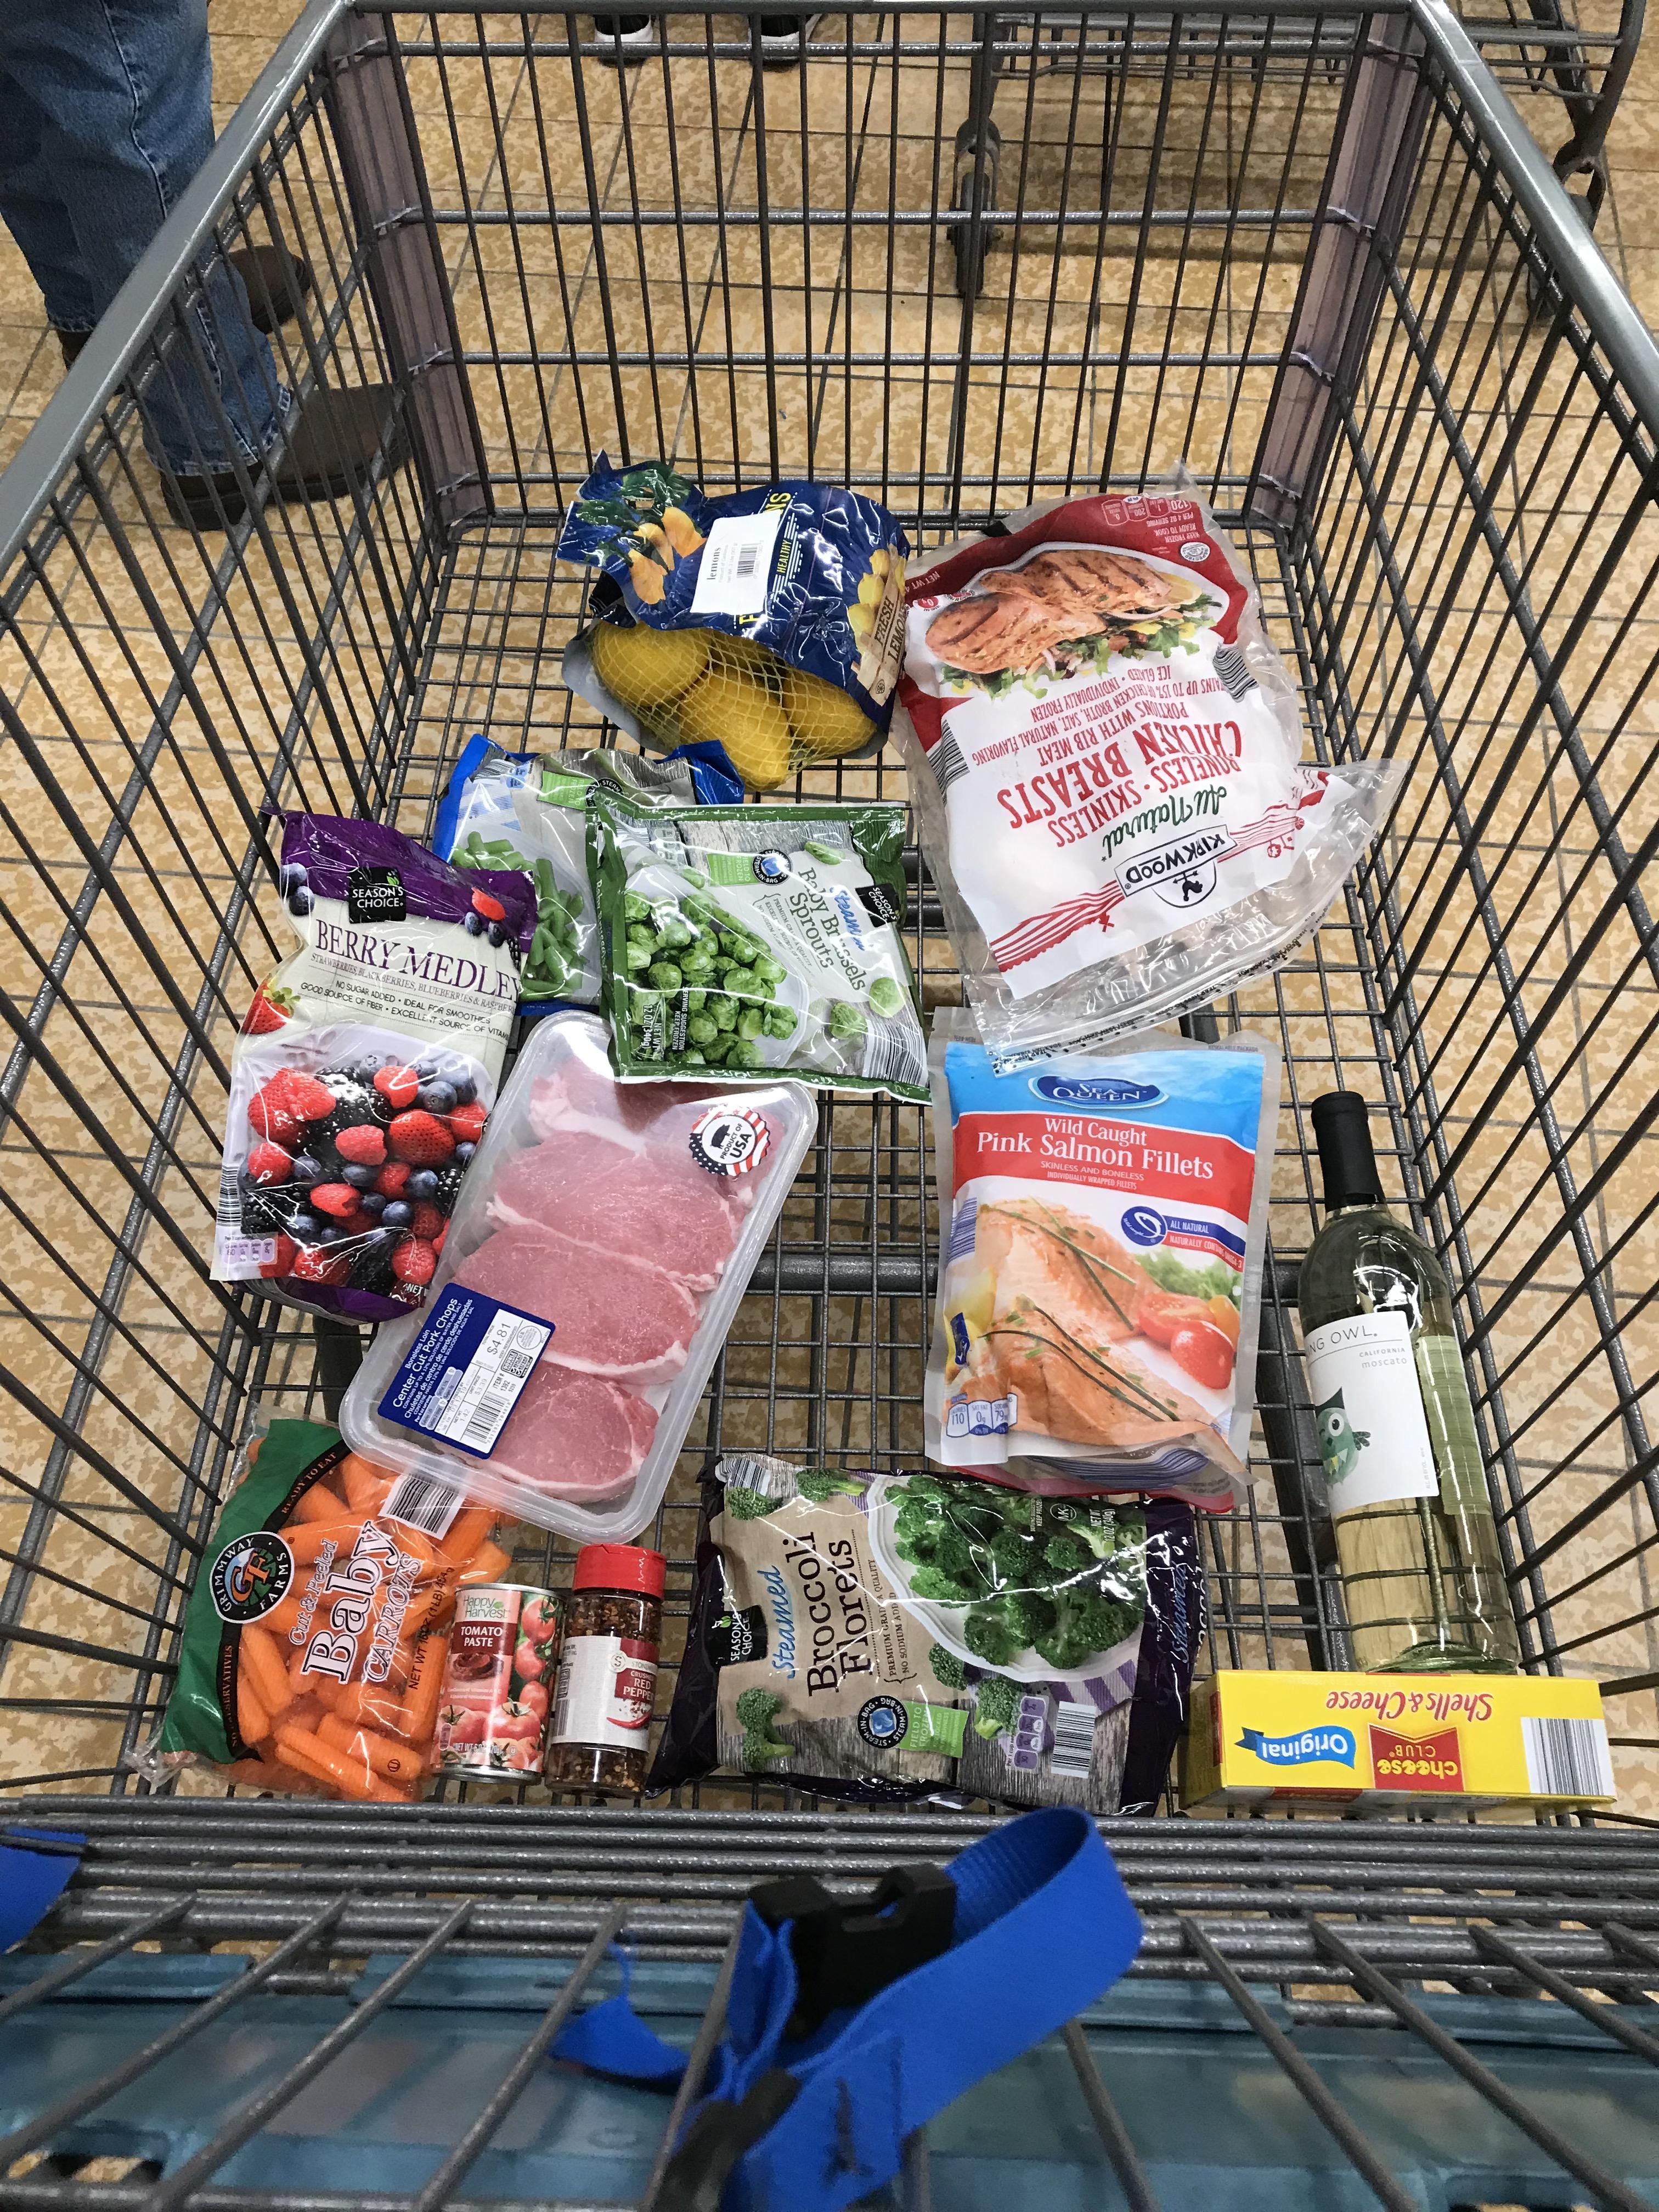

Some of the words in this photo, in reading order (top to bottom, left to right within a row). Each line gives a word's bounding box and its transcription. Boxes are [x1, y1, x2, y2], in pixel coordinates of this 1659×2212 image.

[1178, 522, 1196, 532] READY
[1183, 511, 1194, 520] PER
[1154, 527, 1169, 537] COOK
[1164, 533, 1186, 544] FROZEN
[706, 546, 722, 580] lemons
[776, 540, 792, 573] HEALTHY
[912, 581, 926, 589] WT
[927, 572, 940, 583] NET
[874, 595, 895, 647] FRESH
[1128, 668, 1155, 681] GLAZED
[1157, 665, 1171, 680] ICE
[1063, 677, 1120, 707] INDIVIDUALLY
[1113, 684, 1147, 709] CHICKEN
[1173, 682, 1184, 697] TO
[1187, 680, 1198, 695] UP
[1030, 698, 1064, 723] FROZEN
[1058, 712, 1081, 731] SALT,
[1080, 697, 1113, 722] BROTH,
[1135, 700, 1189, 719] PORTIONS
[1018, 720, 1059, 748] NATURAL
[1098, 709, 1136, 740] WITH
[972, 735, 1019, 766] FLAVORING
[1037, 737, 1074, 766] MEAT
[1074, 727, 1099, 751] RIB
[1133, 720, 1242, 765] CHICKEN
[997, 741, 1132, 829] BREASTS
[1151, 755, 1242, 793] BONELESS
[1194, 784, 1227, 816] All
[1048, 780, 1141, 848] SKINLESS
[1126, 834, 1226, 883] KIRKWOOD
[744, 873, 751, 882] TO
[352, 887, 403, 898] SEASON'S
[872, 885, 898, 921] SEASON'S
[315, 919, 402, 969] BERRY
[790, 894, 834, 969] Sprouts
[301, 982, 323, 996] GOOD
[324, 989, 354, 1005] SOURCE
[356, 997, 365, 1006] OF
[367, 1000, 383, 1011] FIBER
[392, 1007, 436, 1024] EXCELLENT
[439, 1018, 472, 1031] SOURCE
[475, 1024, 486, 1034] OF
[336, 980, 345, 989] NO
[347, 983, 369, 996] SUGAR
[371, 989, 396, 1003] ADDED
[404, 998, 425, 1011] IDEAL
[644, 1015, 652, 1024] OZ
[679, 1013, 687, 1050] SUGGESTION
[641, 1025, 652, 1048] (340g)
[652, 1038, 661, 1048] WT
[1053, 1087, 1139, 1101] QUEEN
[1078, 1083, 1120, 1096] SEA
[720, 1132, 738, 1159] PRODUCT
[736, 1123, 742, 1131] OF
[1045, 1118, 1082, 1135] Wild
[1088, 1122, 1147, 1147] Caught
[730, 1133, 752, 1158] USA
[977, 1132, 1032, 1154] Pink
[1040, 1134, 1133, 1167] Salmon
[1142, 1149, 1213, 1179] Fillets
[1041, 1161, 1078, 1172] SKINLESS
[1102, 1169, 1144, 1181] BONELESS
[1047, 1171, 1086, 1182] INDIVIDUALLY
[1088, 1176, 1115, 1186] WRAPPED
[1116, 1180, 1137, 1189] FILLETS
[1170, 1220, 1181, 1229] ALL
[1182, 1222, 1209, 1233] NATURAL
[1170, 1235, 1201, 1248] NATURALLY
[486, 1322, 511, 1356] $4.81
[1330, 1325, 1373, 1344] OWL
[392, 1372, 417, 1409] Center
[411, 1352, 428, 1373] Cut
[422, 1328, 441, 1353] Pork
[435, 1296, 461, 1331] Chops
[404, 1341, 424, 1370] Boneless
[419, 1328, 431, 1342] Loin
[404, 1390, 423, 1419] Chuletas
[419, 1381, 428, 1391] de
[424, 1361, 438, 1382] centro
[434, 1352, 443, 1363] de
[439, 1335, 453, 1354] cerdo
[449, 1297, 473, 1337] deshuesadas
[1359, 1348, 1405, 1357] CALIFORNIA
[402, 1387, 416, 1409] CONTAINS
[422, 1362, 431, 1372] 12%
[427, 1341, 442, 1363] SOLUTION
[442, 1321, 452, 1336] WATER
[1362, 1357, 1407, 1368] moscato
[424, 1380, 435, 1395] HASTA
[493, 1376, 503, 1389] ITEM
[500, 1379, 510, 1392] 1392
[952, 1413, 964, 1425] 110
[281, 1481, 306, 1514] READY
[305, 1469, 318, 1482] TO
[318, 1453, 337, 1470] EAT
[1091, 1515, 1102, 1527] NET
[1103, 1526, 1115, 1534] OZ
[215, 1537, 255, 1612] GRIMMWAY
[307, 1539, 338, 1595] Peeled
[435, 1565, 455, 1590] 454g
[867, 1558, 882, 1592] QUALITY
[259, 1552, 289, 1611] FARMS
[300, 1519, 400, 1684] Baby
[300, 1595, 317, 1612] &
[463, 1595, 495, 1609] Happy
[465, 1607, 507, 1619] Harvest
[782, 1531, 839, 1697] Broccoli
[827, 1539, 873, 1676] Florets
[889, 1592, 901, 1621] ADDD
[290, 1612, 312, 1645] Cut
[363, 1552, 422, 1682] CARROTS
[757, 1565, 796, 1680] Steamed
[460, 1627, 503, 1636] TOMATO
[464, 1637, 493, 1647] PASTE
[730, 1613, 742, 1661] SEASON'S
[895, 1623, 907, 1659] SODIUM
[414, 1646, 428, 1665] WT
[883, 1633, 896, 1677] PREMIUM
[901, 1660, 909, 1673] NO
[407, 1666, 424, 1690] NET
[634, 1678, 651, 1690] RED
[913, 1706, 922, 1719] TO
[1326, 1691, 1406, 1720] Cheese
[1426, 1693, 1494, 1722] Shells
[909, 1722, 921, 1747] FIELD
[1262, 1734, 1347, 1760] Original
[1396, 1745, 1436, 1757] CLUB
[1377, 1759, 1458, 1779] cheese
